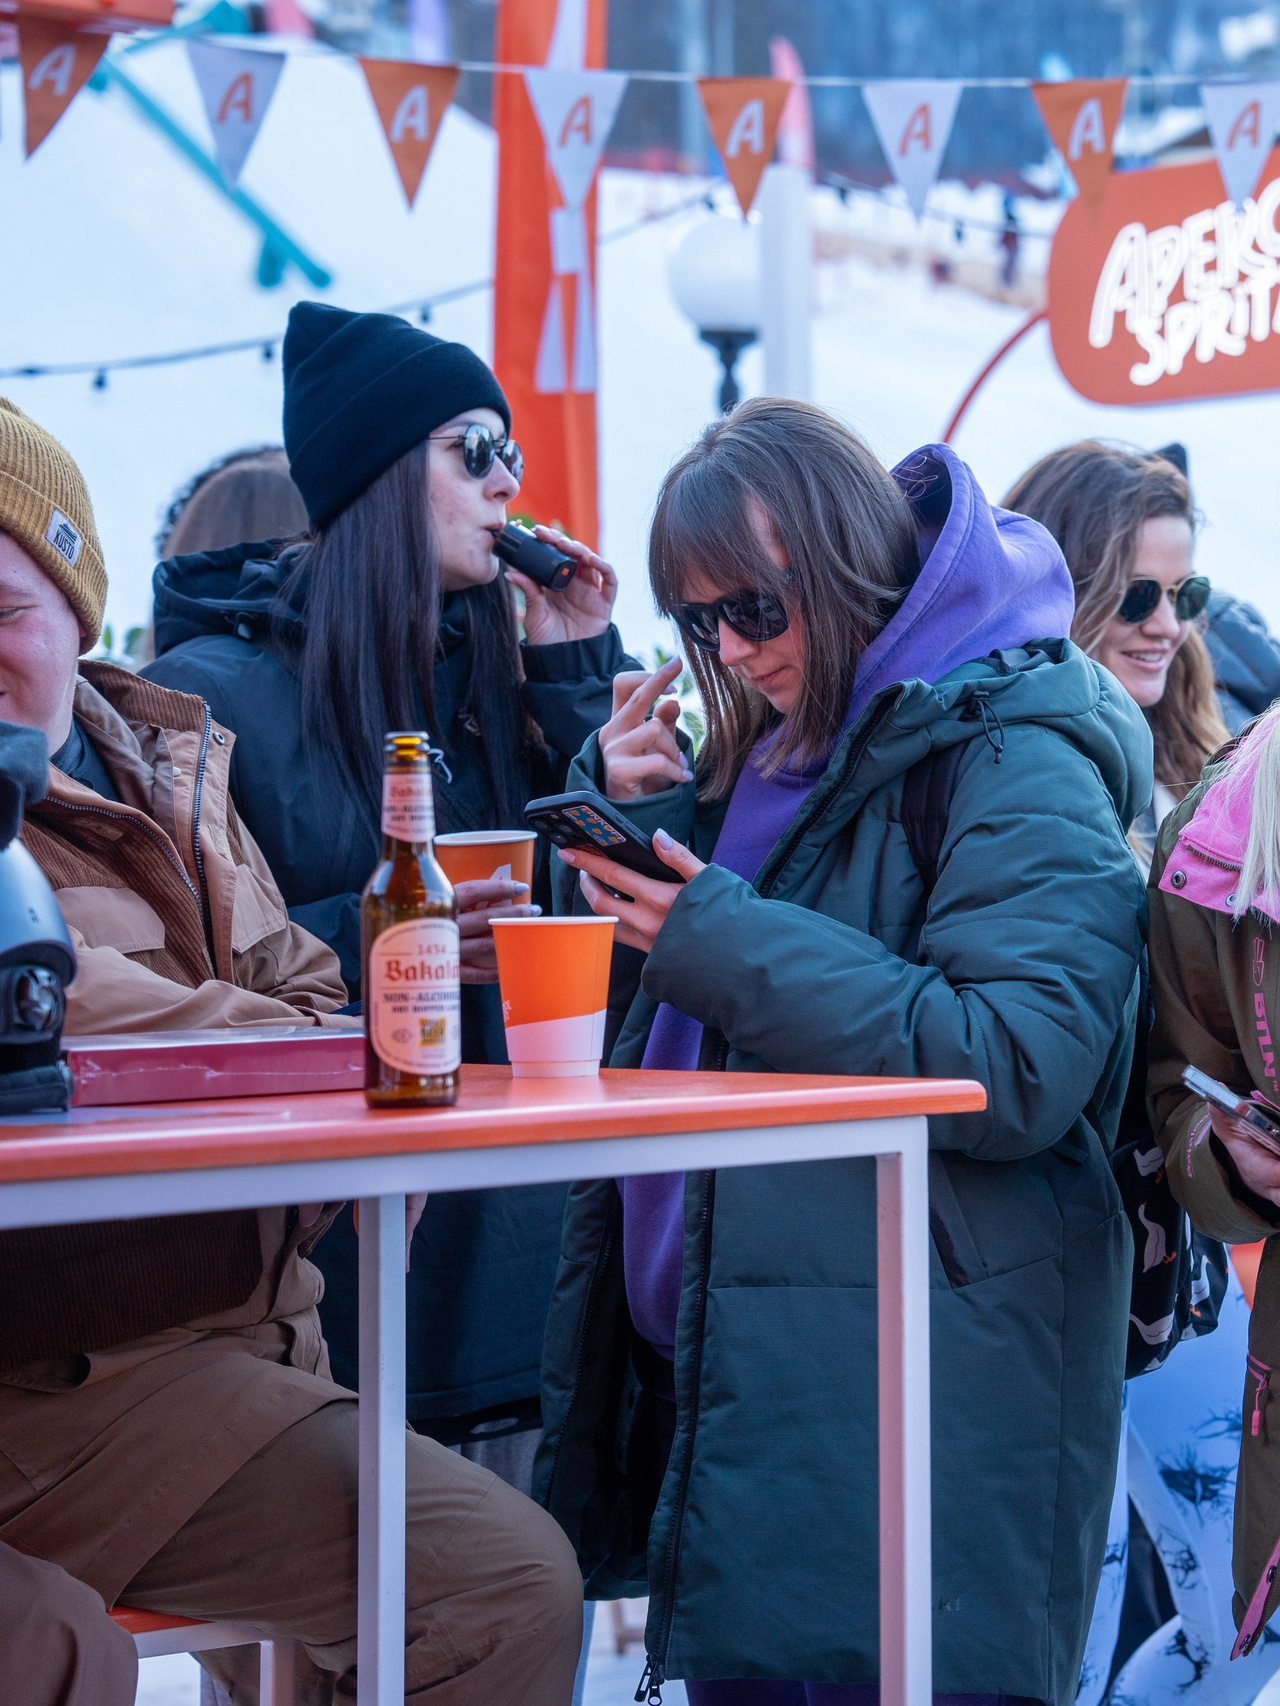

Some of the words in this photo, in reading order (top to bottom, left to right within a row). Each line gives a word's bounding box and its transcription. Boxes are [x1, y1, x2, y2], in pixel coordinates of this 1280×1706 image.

[29, 45, 75, 96] A
[217, 71, 254, 124] A
[391, 86, 429, 143] A
[559, 95, 594, 148] A
[727, 100, 765, 158] A
[899, 103, 931, 158] A
[1069, 98, 1105, 160] A
[1227, 101, 1261, 150] A
[53, 530, 75, 560] KUSTO
